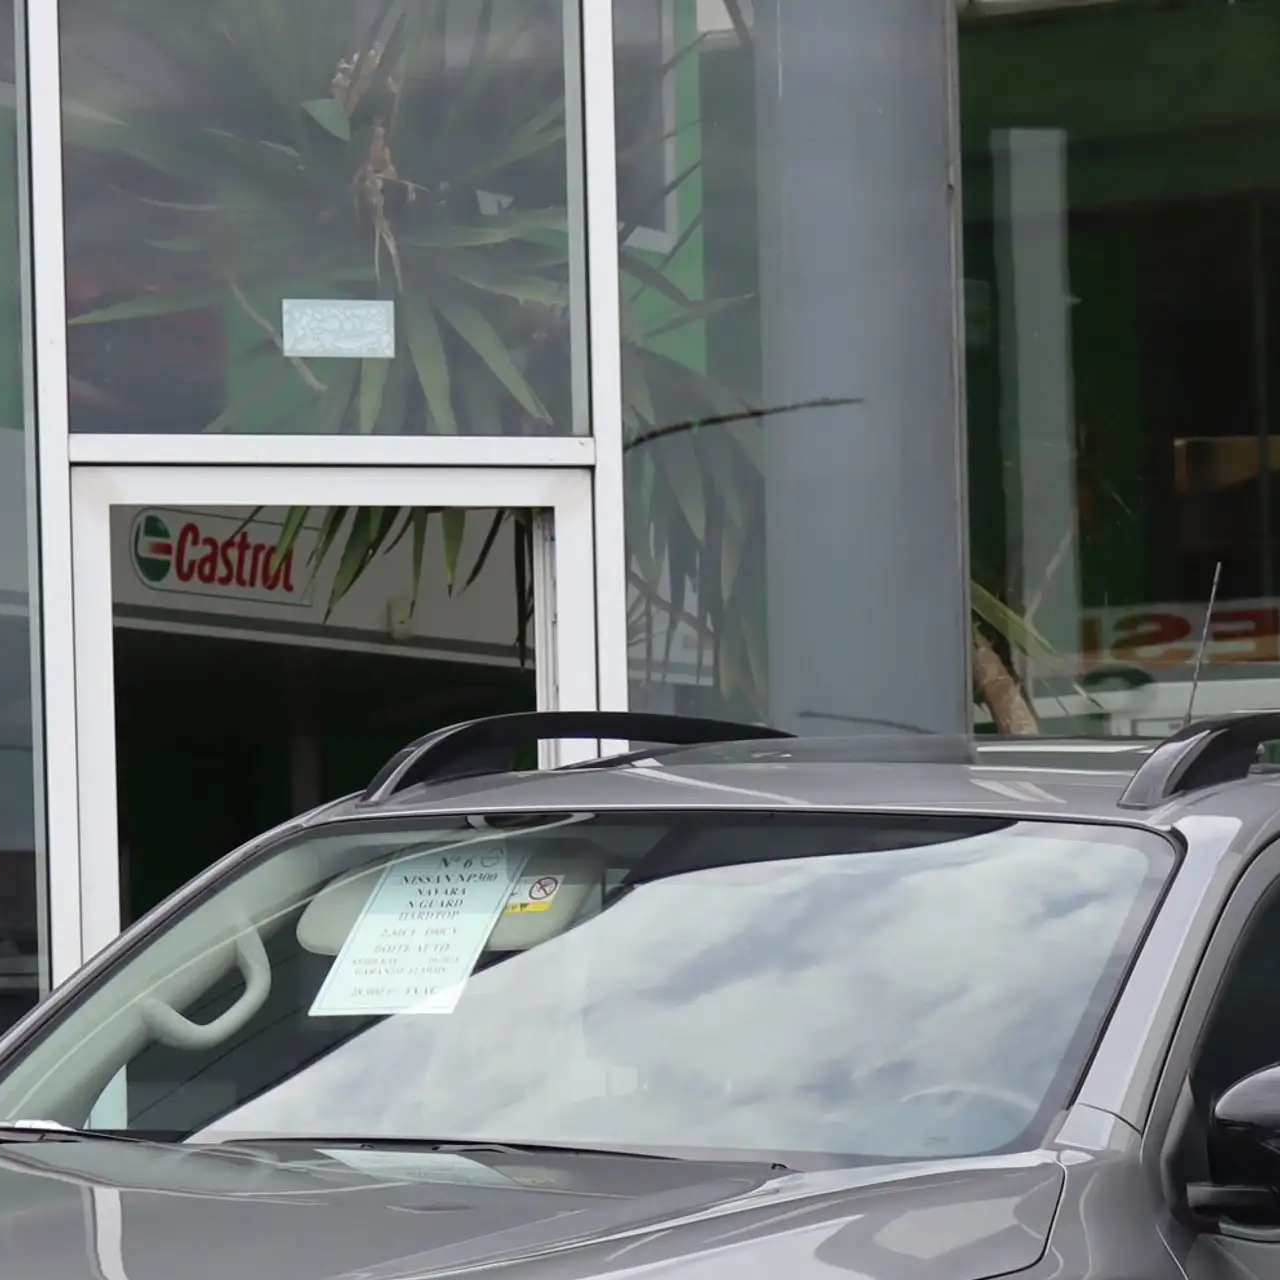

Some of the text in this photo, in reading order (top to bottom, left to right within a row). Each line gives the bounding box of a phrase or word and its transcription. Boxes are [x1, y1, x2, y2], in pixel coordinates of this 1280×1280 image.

[175, 522, 294, 593] Castrol
[401, 872, 498, 885] NISSAN NP300
[416, 886, 467, 897] NAVARA
